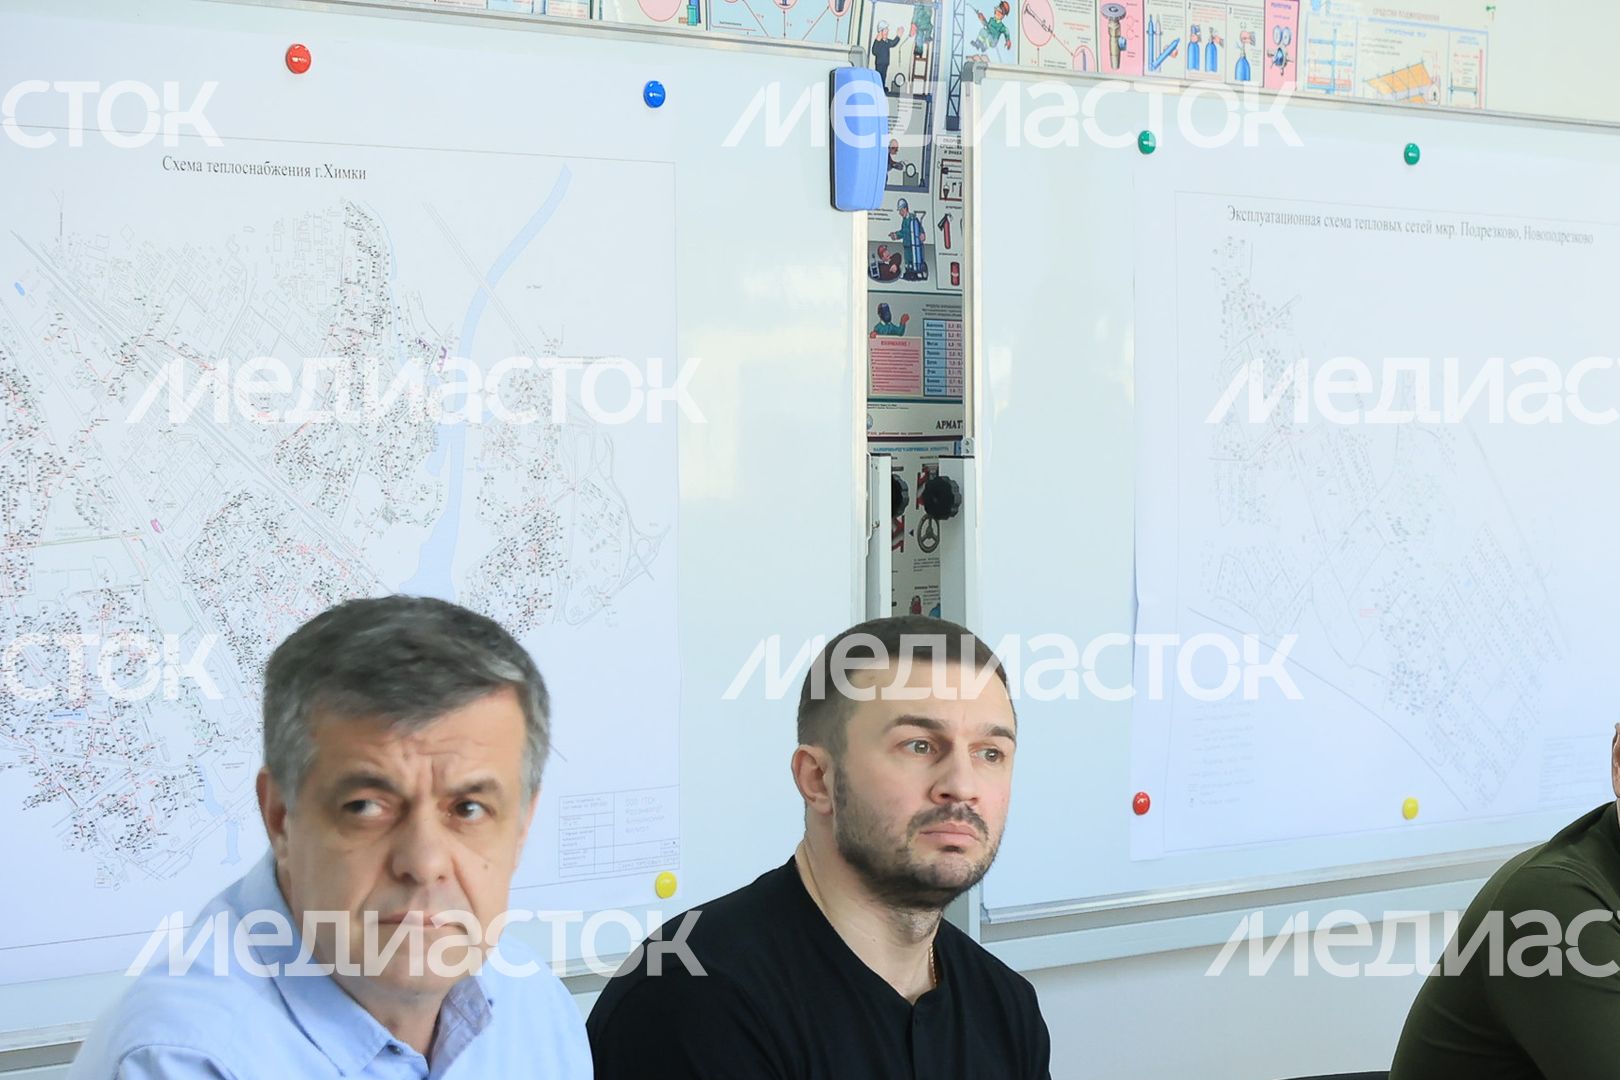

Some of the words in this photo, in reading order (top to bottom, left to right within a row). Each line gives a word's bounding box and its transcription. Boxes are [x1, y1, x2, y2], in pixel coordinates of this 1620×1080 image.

[162, 155, 203, 173] Схема
[206, 160, 311, 178] теплоснабжения
[1227, 205, 1321, 227] Эксплуатационная
[1323, 214, 1352, 229] схема
[1354, 217, 1403, 233] тепловых
[1405, 219, 1433, 234] сетей
